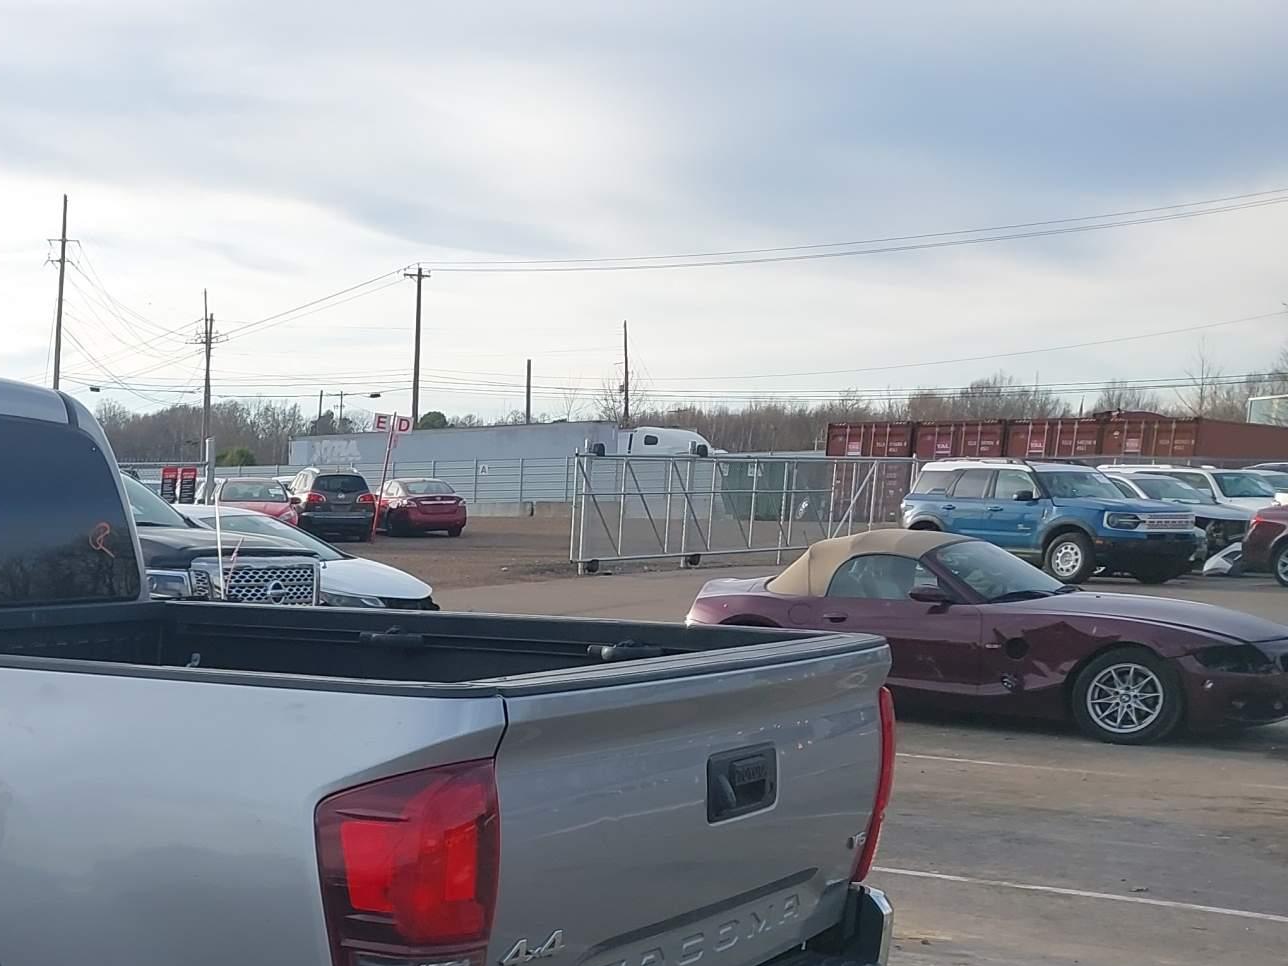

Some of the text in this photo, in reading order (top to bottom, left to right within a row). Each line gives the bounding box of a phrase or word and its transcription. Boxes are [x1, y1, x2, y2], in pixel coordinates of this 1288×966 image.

[375, 415, 410, 432] E D
[500, 928, 566, 962] 4x4
